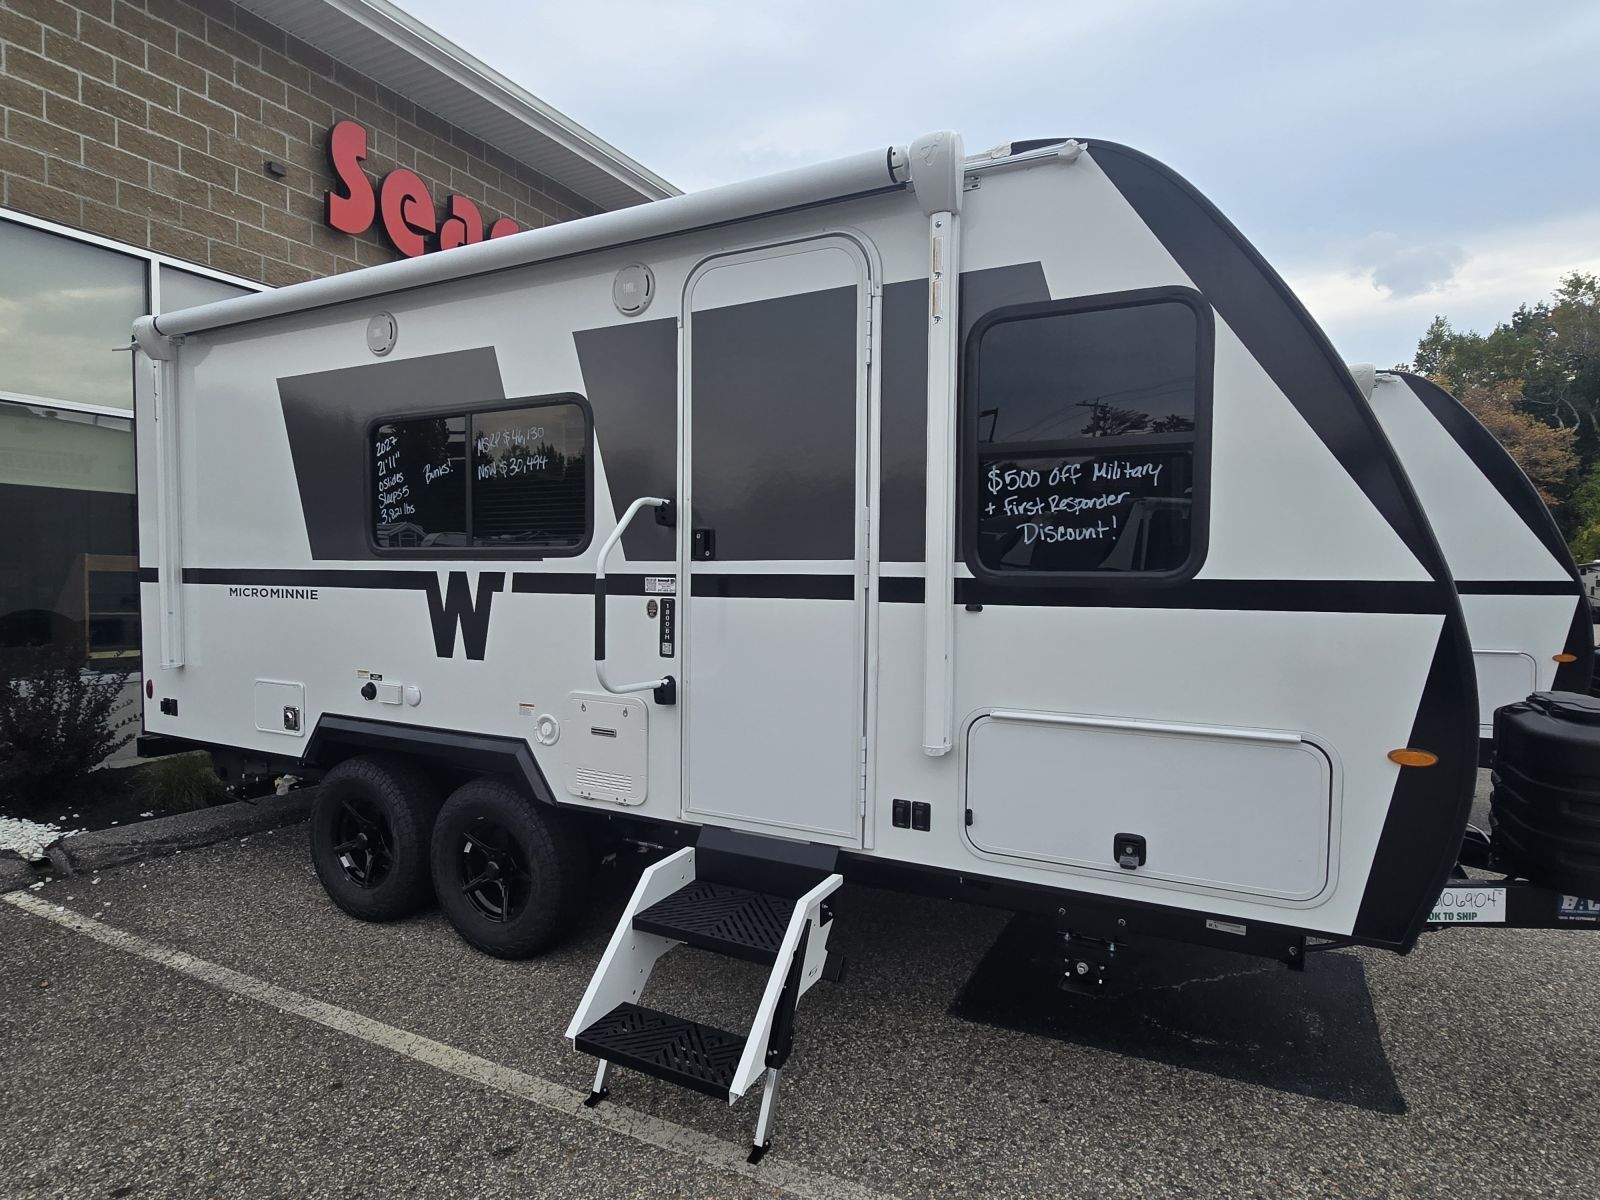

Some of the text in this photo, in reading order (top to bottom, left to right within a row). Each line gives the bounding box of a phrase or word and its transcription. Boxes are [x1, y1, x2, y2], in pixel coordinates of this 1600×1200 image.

[376, 436, 399, 457] 2027
[499, 455, 549, 479] $30,494
[987, 465, 1041, 495] $500
[1092, 461, 1163, 487] Military
[1048, 492, 1131, 516] Responder
[1016, 515, 1117, 545] Discount!
[1443, 911, 1455, 921] TO
[1456, 911, 1478, 921] SHIP
